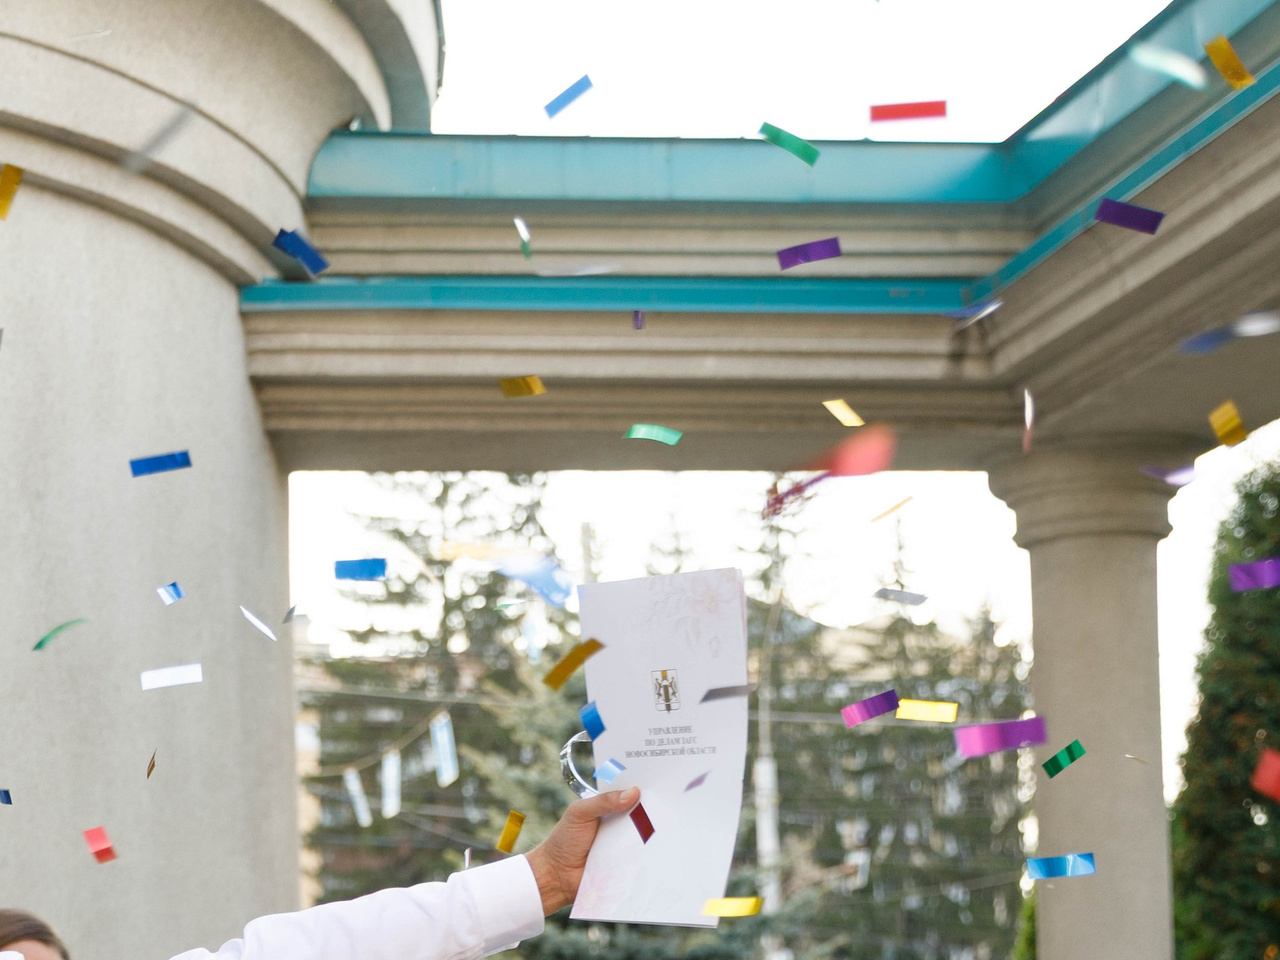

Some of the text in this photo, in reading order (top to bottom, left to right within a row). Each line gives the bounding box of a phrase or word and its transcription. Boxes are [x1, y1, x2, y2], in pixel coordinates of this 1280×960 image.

[648, 726, 693, 735] УПРАВЛЕНИЕ
[656, 738, 680, 746] ДЕЛАМ
[681, 736, 698, 744] ЗАГС
[625, 747, 716, 758] НОВОСИБИРСКОЙ ОБЛАСТИ
